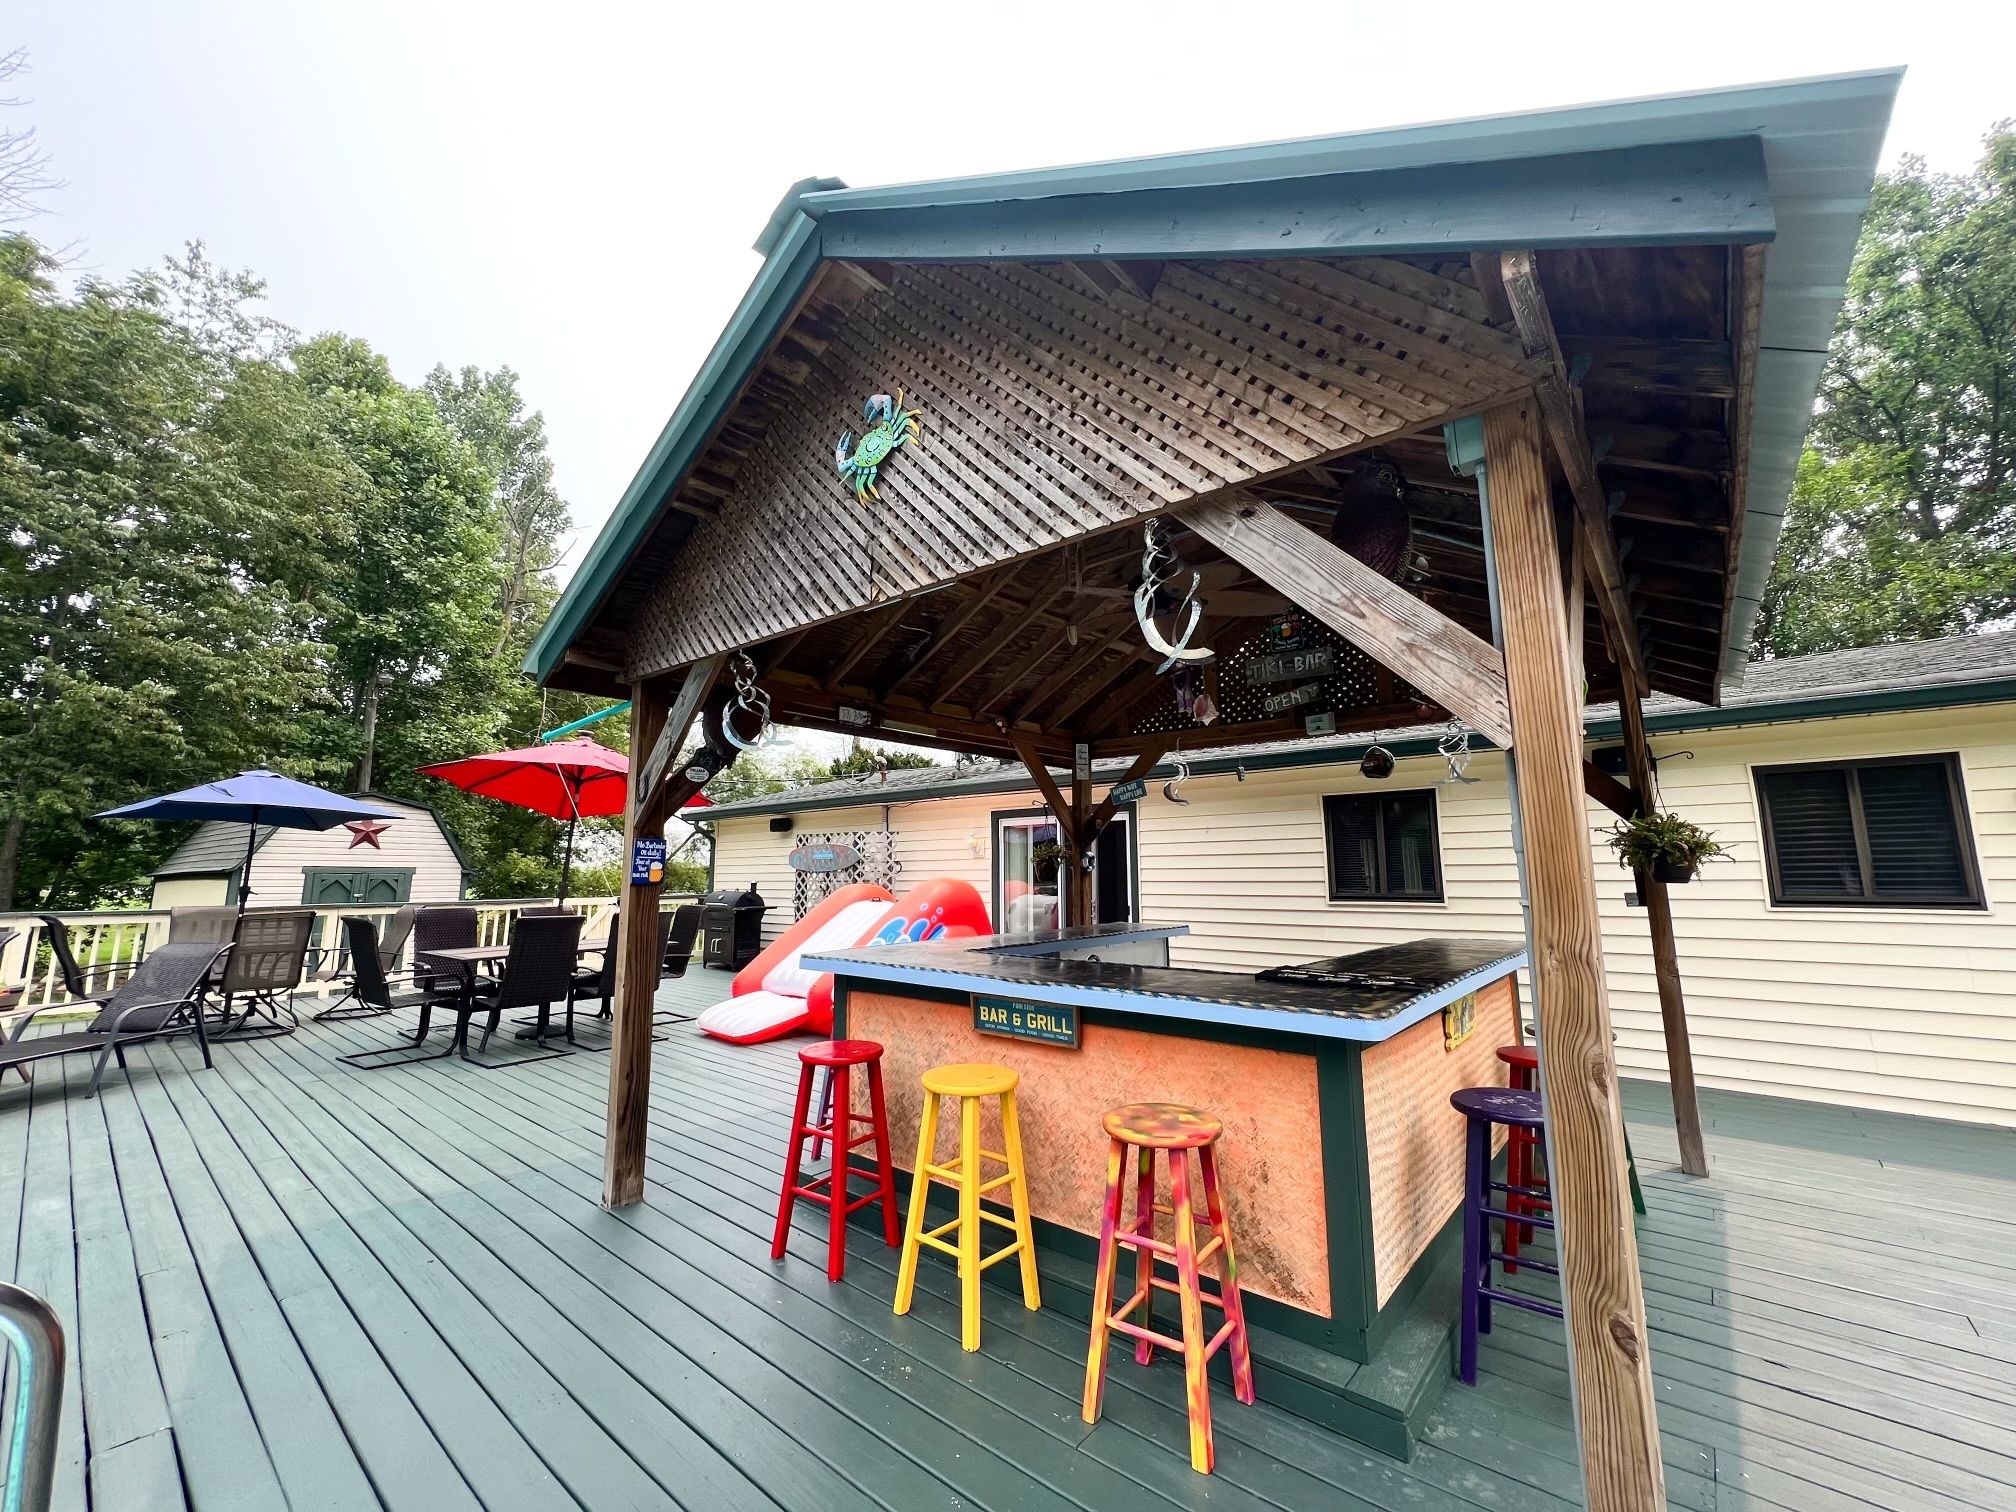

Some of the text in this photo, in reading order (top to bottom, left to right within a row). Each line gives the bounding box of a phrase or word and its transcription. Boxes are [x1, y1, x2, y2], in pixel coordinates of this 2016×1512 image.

[1250, 653, 1326, 679] TIKI-BAR
[1264, 689, 1301, 711] OPEN
[1112, 785, 1127, 796] HAPPY
[1119, 791, 1134, 801] HAPPY
[637, 840, 645, 848] No
[647, 849, 661, 857] duty!
[980, 1006, 1072, 1034] BAR & GRILL
